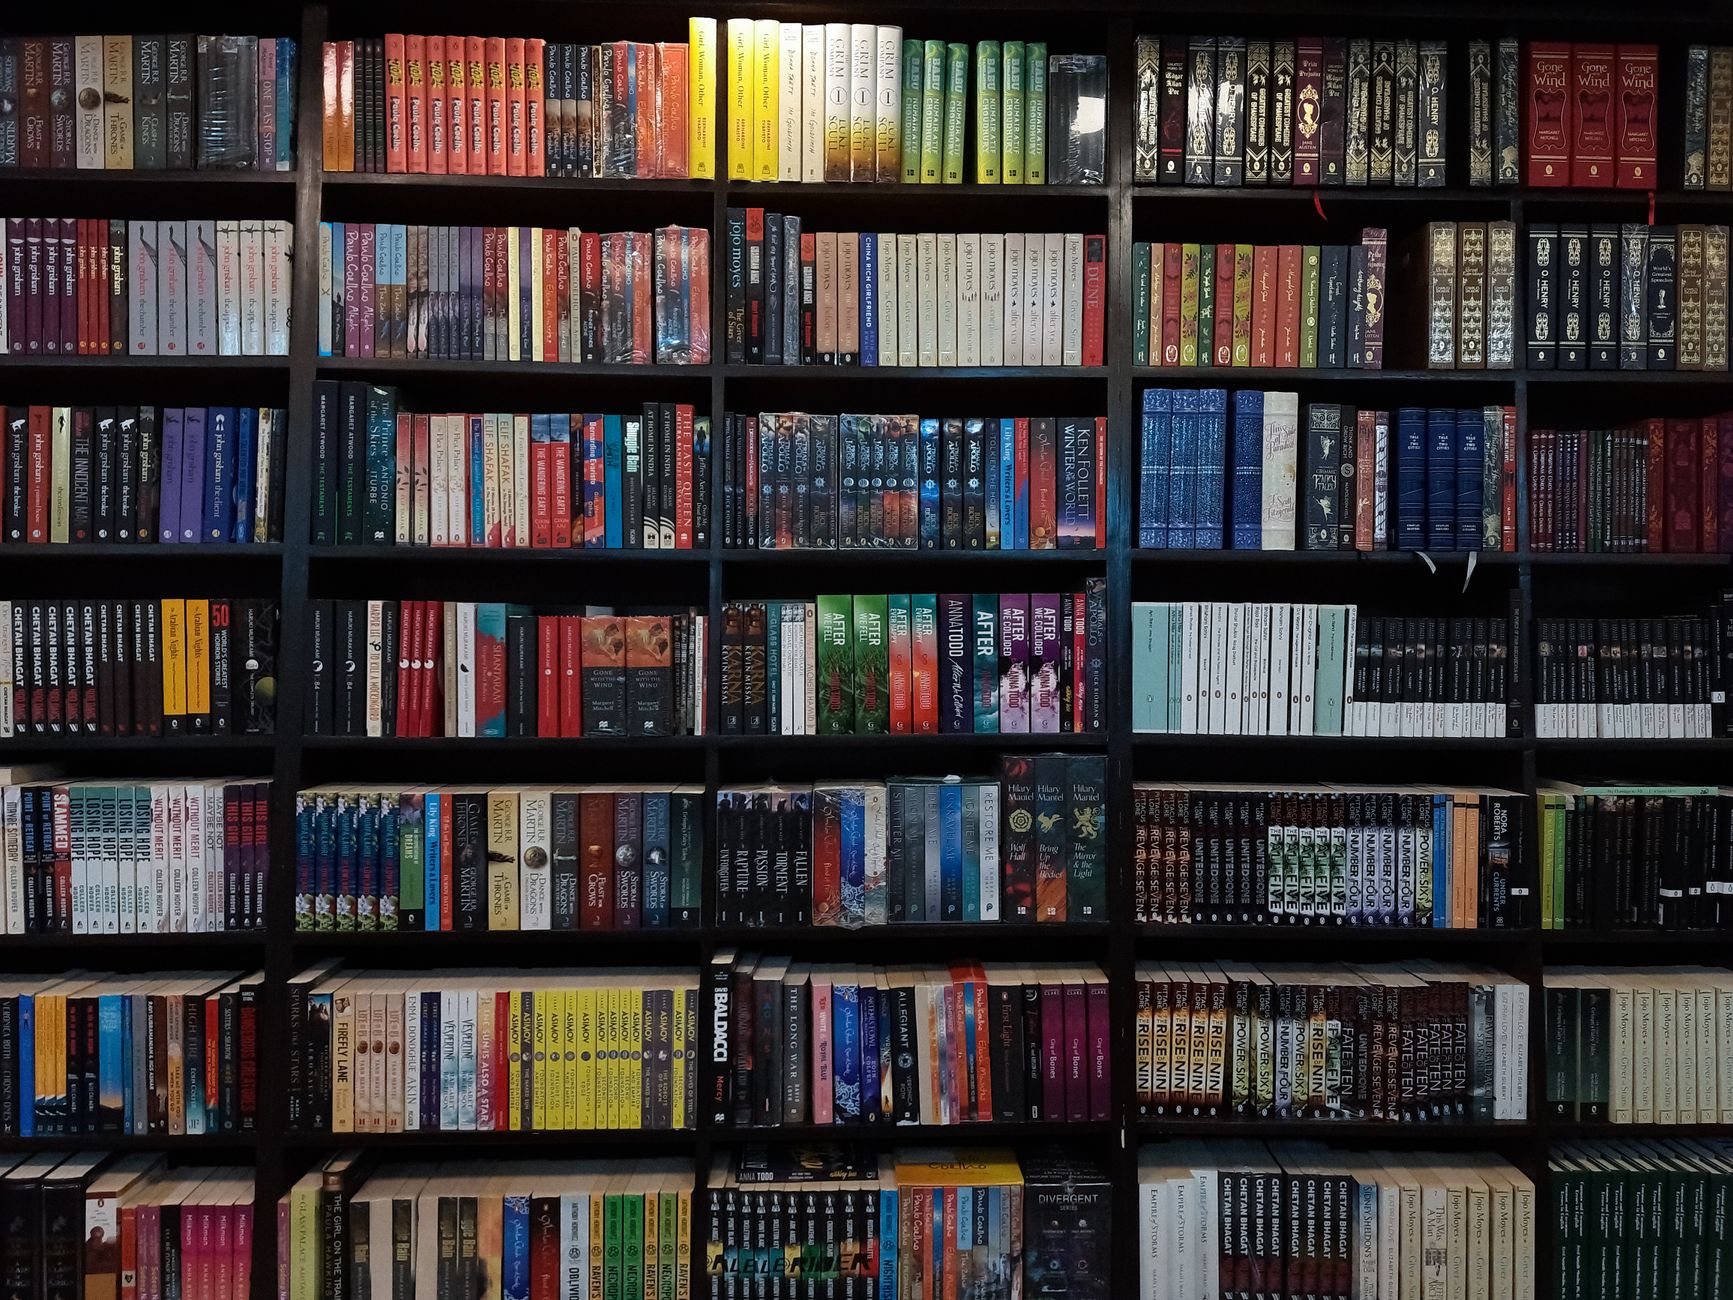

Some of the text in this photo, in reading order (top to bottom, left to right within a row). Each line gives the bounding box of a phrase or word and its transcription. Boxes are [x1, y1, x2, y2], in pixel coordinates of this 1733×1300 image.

[53, 42, 63, 86] MARTIN
[762, 53, 770, 84] Woman,
[885, 40, 895, 79] GRIM
[1010, 58, 1020, 90] BABU
[1537, 62, 1563, 72] Gone
[762, 86, 770, 108] Other
[1275, 92, 1282, 101] OF
[1534, 73, 1565, 86] Wind
[26, 116, 36, 148] CROWS
[110, 112, 119, 154] THRONES
[263, 81, 272, 155] ONE LAST STOP
[492, 101, 501, 154] Paulo Coelho
[838, 118, 848, 150] LUKE
[1029, 100, 1037, 154] CHOUDHURY
[1036, 100, 1044, 131] NUMAIR
[1283, 89, 1292, 146] GREATEST COMEDIES
[47, 247, 56, 295] john grisham
[113, 246, 122, 295] john grisham
[585, 238, 594, 288] Paulo Coelho
[731, 222, 743, 287] jojo moyes
[987, 241, 998, 290] jojo moyes
[345, 232, 360, 332] Paulo Coelho Aleph
[1087, 266, 1099, 309] DUNE
[728, 311, 735, 319] of
[735, 307, 744, 343] The Giver
[346, 395, 354, 430] MARGARET
[664, 410, 670, 419] AT
[121, 434, 131, 449] john
[369, 425, 380, 456] Skies
[381, 419, 392, 456] Prince
[499, 420, 510, 484] ELIF SHAFAK
[624, 422, 640, 472] Shuggie Bain
[664, 445, 670, 453] IN
[1064, 424, 1075, 471] WINTER
[75, 438, 89, 503] THE INNOCENT
[121, 452, 131, 483] grisham
[557, 447, 565, 514] THE WANDERING EARTH
[683, 412, 691, 527] THE LAST QUEEN
[1078, 429, 1089, 519] KEN FOLLETT
[346, 476, 354, 516] TESTAMENTS
[380, 466, 388, 510] ANTONIO
[212, 605, 230, 627] 50
[370, 604, 379, 637] HARPER LEE
[860, 612, 868, 642] WE FELL
[868, 613, 880, 645] AFTER
[1034, 608, 1043, 655] WE COLLIDED
[1043, 608, 1055, 640] AFTER
[85, 607, 94, 685] CHETAN BHAGAT
[370, 662, 379, 673] KILL
[493, 645, 501, 703] SHANTARAM
[369, 682, 379, 721] MOCKINGBIRD
[1008, 785, 1031, 794] Hilary
[1038, 786, 1060, 794] Hilary
[55, 794, 66, 848] SLAMMED
[136, 799, 150, 862] LOSING HOPE
[494, 800, 505, 843] MARTIN
[985, 793, 994, 860] RESTORE ME
[1493, 803, 1501, 840] ROBERTS
[1010, 844, 1025, 852] Wolf
[720, 849, 728, 892] UNFORGIVEN
[736, 851, 748, 892] RAPTURE
[755, 850, 768, 886] PASSION
[775, 851, 786, 893] TORMENT
[795, 851, 806, 886] FALLEN
[650, 870, 660, 909] SWORDS
[2, 1002, 12, 1059] VERONICA ROTH
[687, 1010, 696, 1041] ASIMOV
[715, 993, 727, 1062] BALDACCI
[790, 1015, 798, 1048] LONG
[1000, 1004, 1012, 1047] First Light
[1702, 996, 1712, 1038] Jojo Moyes
[337, 1023, 348, 1083] FIREFLY LANE
[407, 996, 416, 1104] EMMA DONOGHUE AKIN
[1313, 1028, 1323, 1057] RISE
[1455, 1023, 1465, 1055] FATE
[790, 1054, 798, 1078] WAR
[1096, 1056, 1104, 1078] Bones
[1455, 1062, 1466, 1089] TEN
[3, 1071, 12, 1121] CHOSEN ONES
[714, 1076, 725, 1101] Mercy
[1039, 1194, 1098, 1203] DIVERGENT
[1224, 1178, 1232, 1255] CHETAN BHAGAT
[334, 1241, 341, 1256] ON
